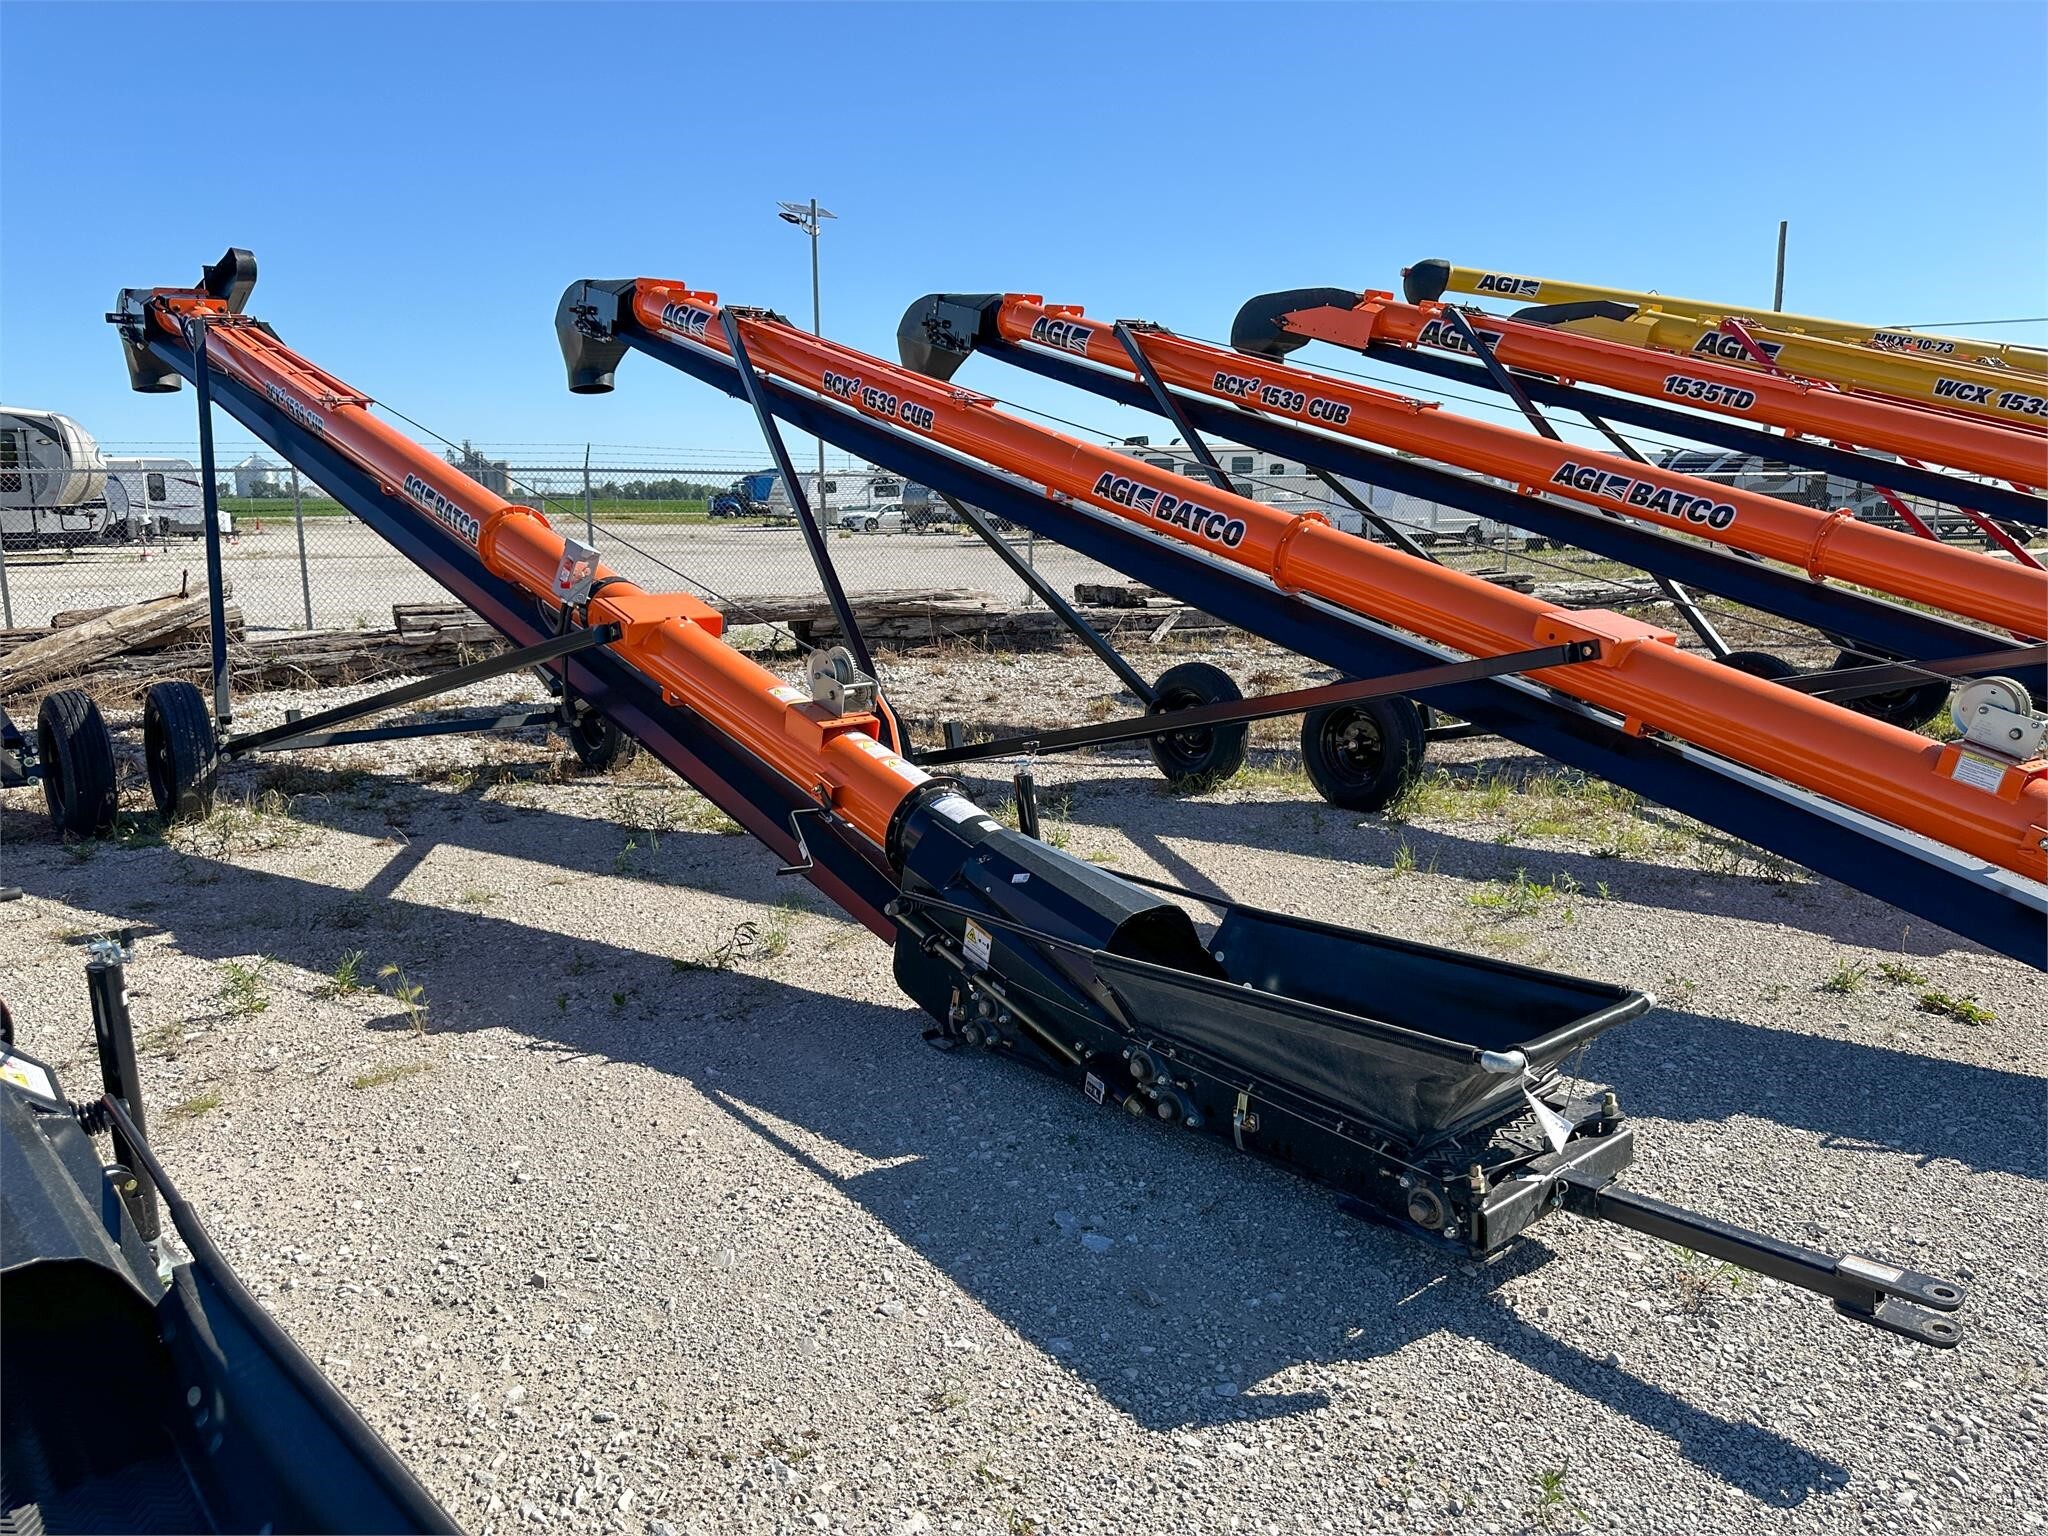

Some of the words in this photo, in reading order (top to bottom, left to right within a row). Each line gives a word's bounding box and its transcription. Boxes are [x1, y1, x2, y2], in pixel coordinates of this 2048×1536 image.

[1477, 274, 1520, 293] AGI
[662, 303, 696, 333] AGI
[1031, 317, 1073, 347] AGI
[1916, 339, 1954, 354] 10-73
[1261, 386, 1305, 412] 1539
[1308, 398, 1351, 424] CUB
[1665, 375, 1755, 409] 1535TD
[1933, 379, 1994, 404] WCX
[861, 387, 897, 416] 1539
[900, 402, 934, 431] CUB
[403, 474, 425, 505] AGI
[435, 495, 479, 545] BATCO
[1093, 473, 1139, 507] AGI
[1155, 494, 1245, 547] BATCO
[1552, 463, 1607, 493] AGI
[1627, 481, 1736, 530] BATCO
